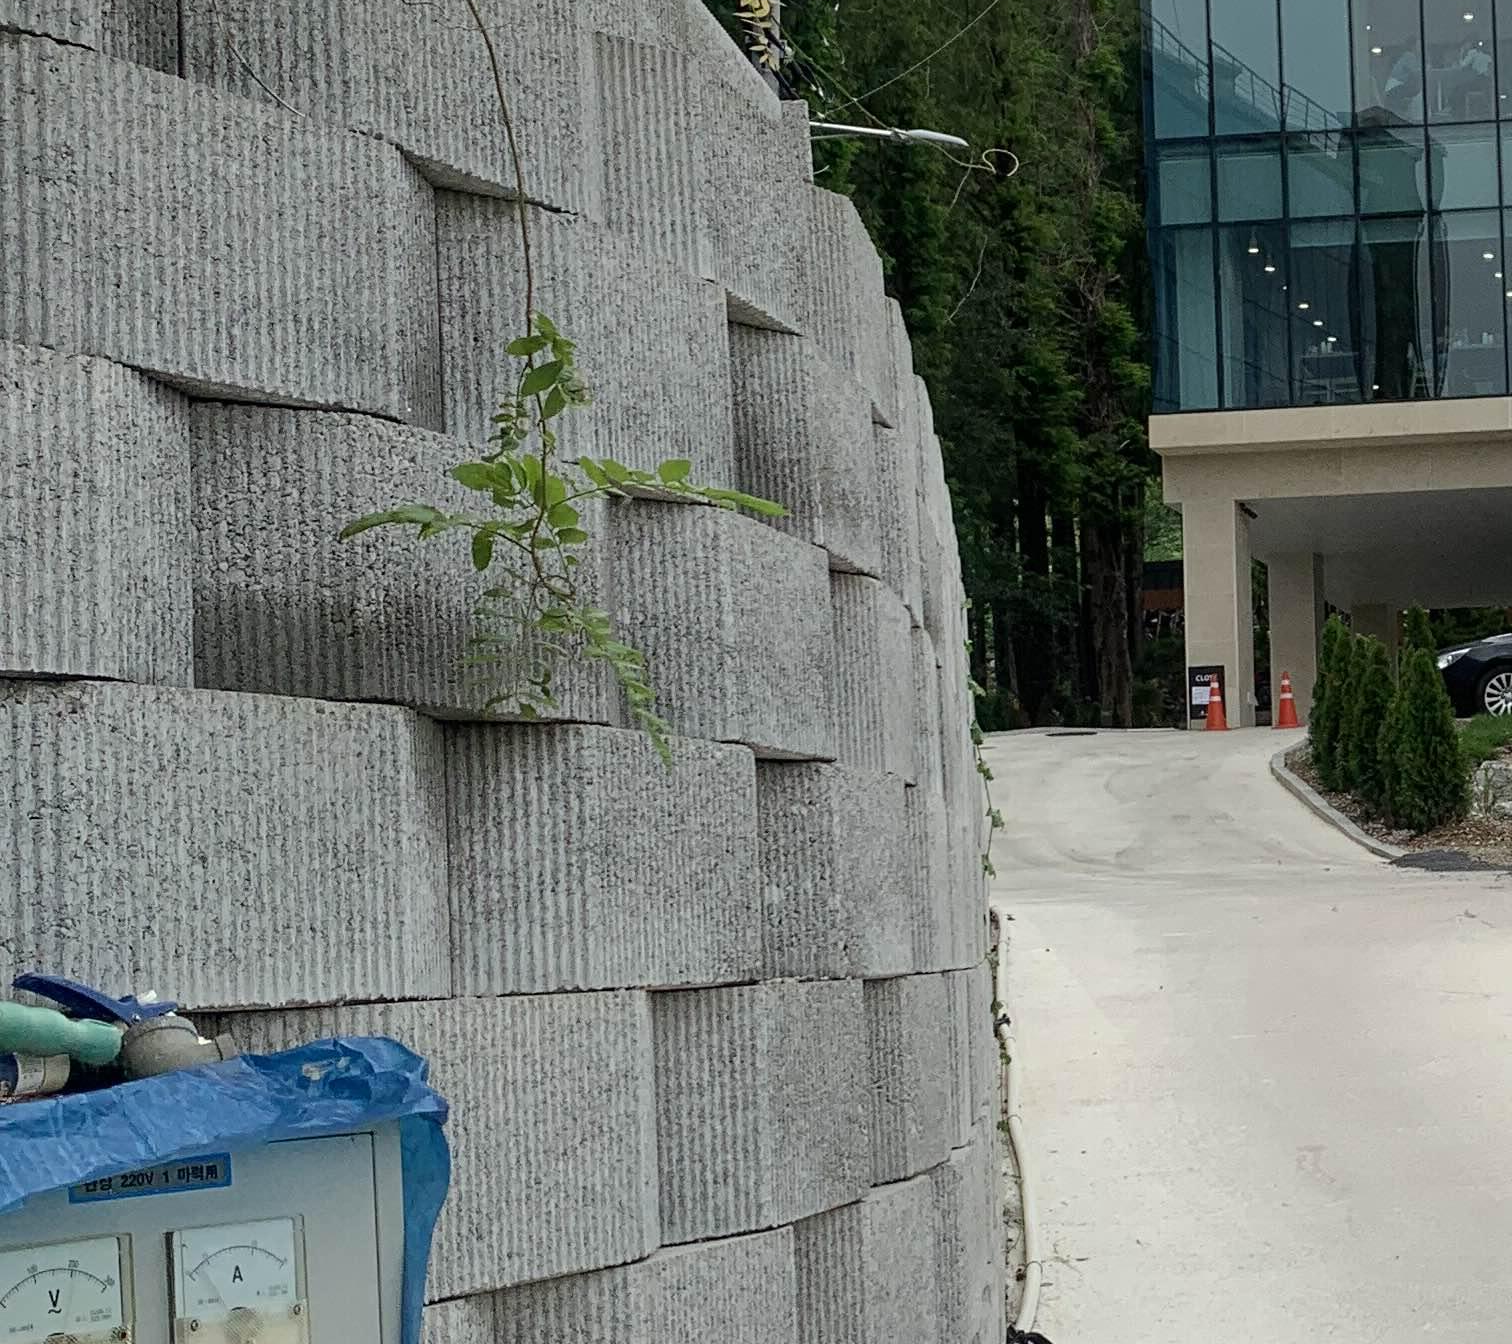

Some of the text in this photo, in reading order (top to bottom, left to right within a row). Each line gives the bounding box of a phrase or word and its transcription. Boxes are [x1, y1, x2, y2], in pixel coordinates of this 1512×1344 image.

[120, 1170, 154, 1188] 220V
[162, 1170, 170, 1184] 1
[232, 1264, 244, 1283] A
[48, 1288, 60, 1308] V
